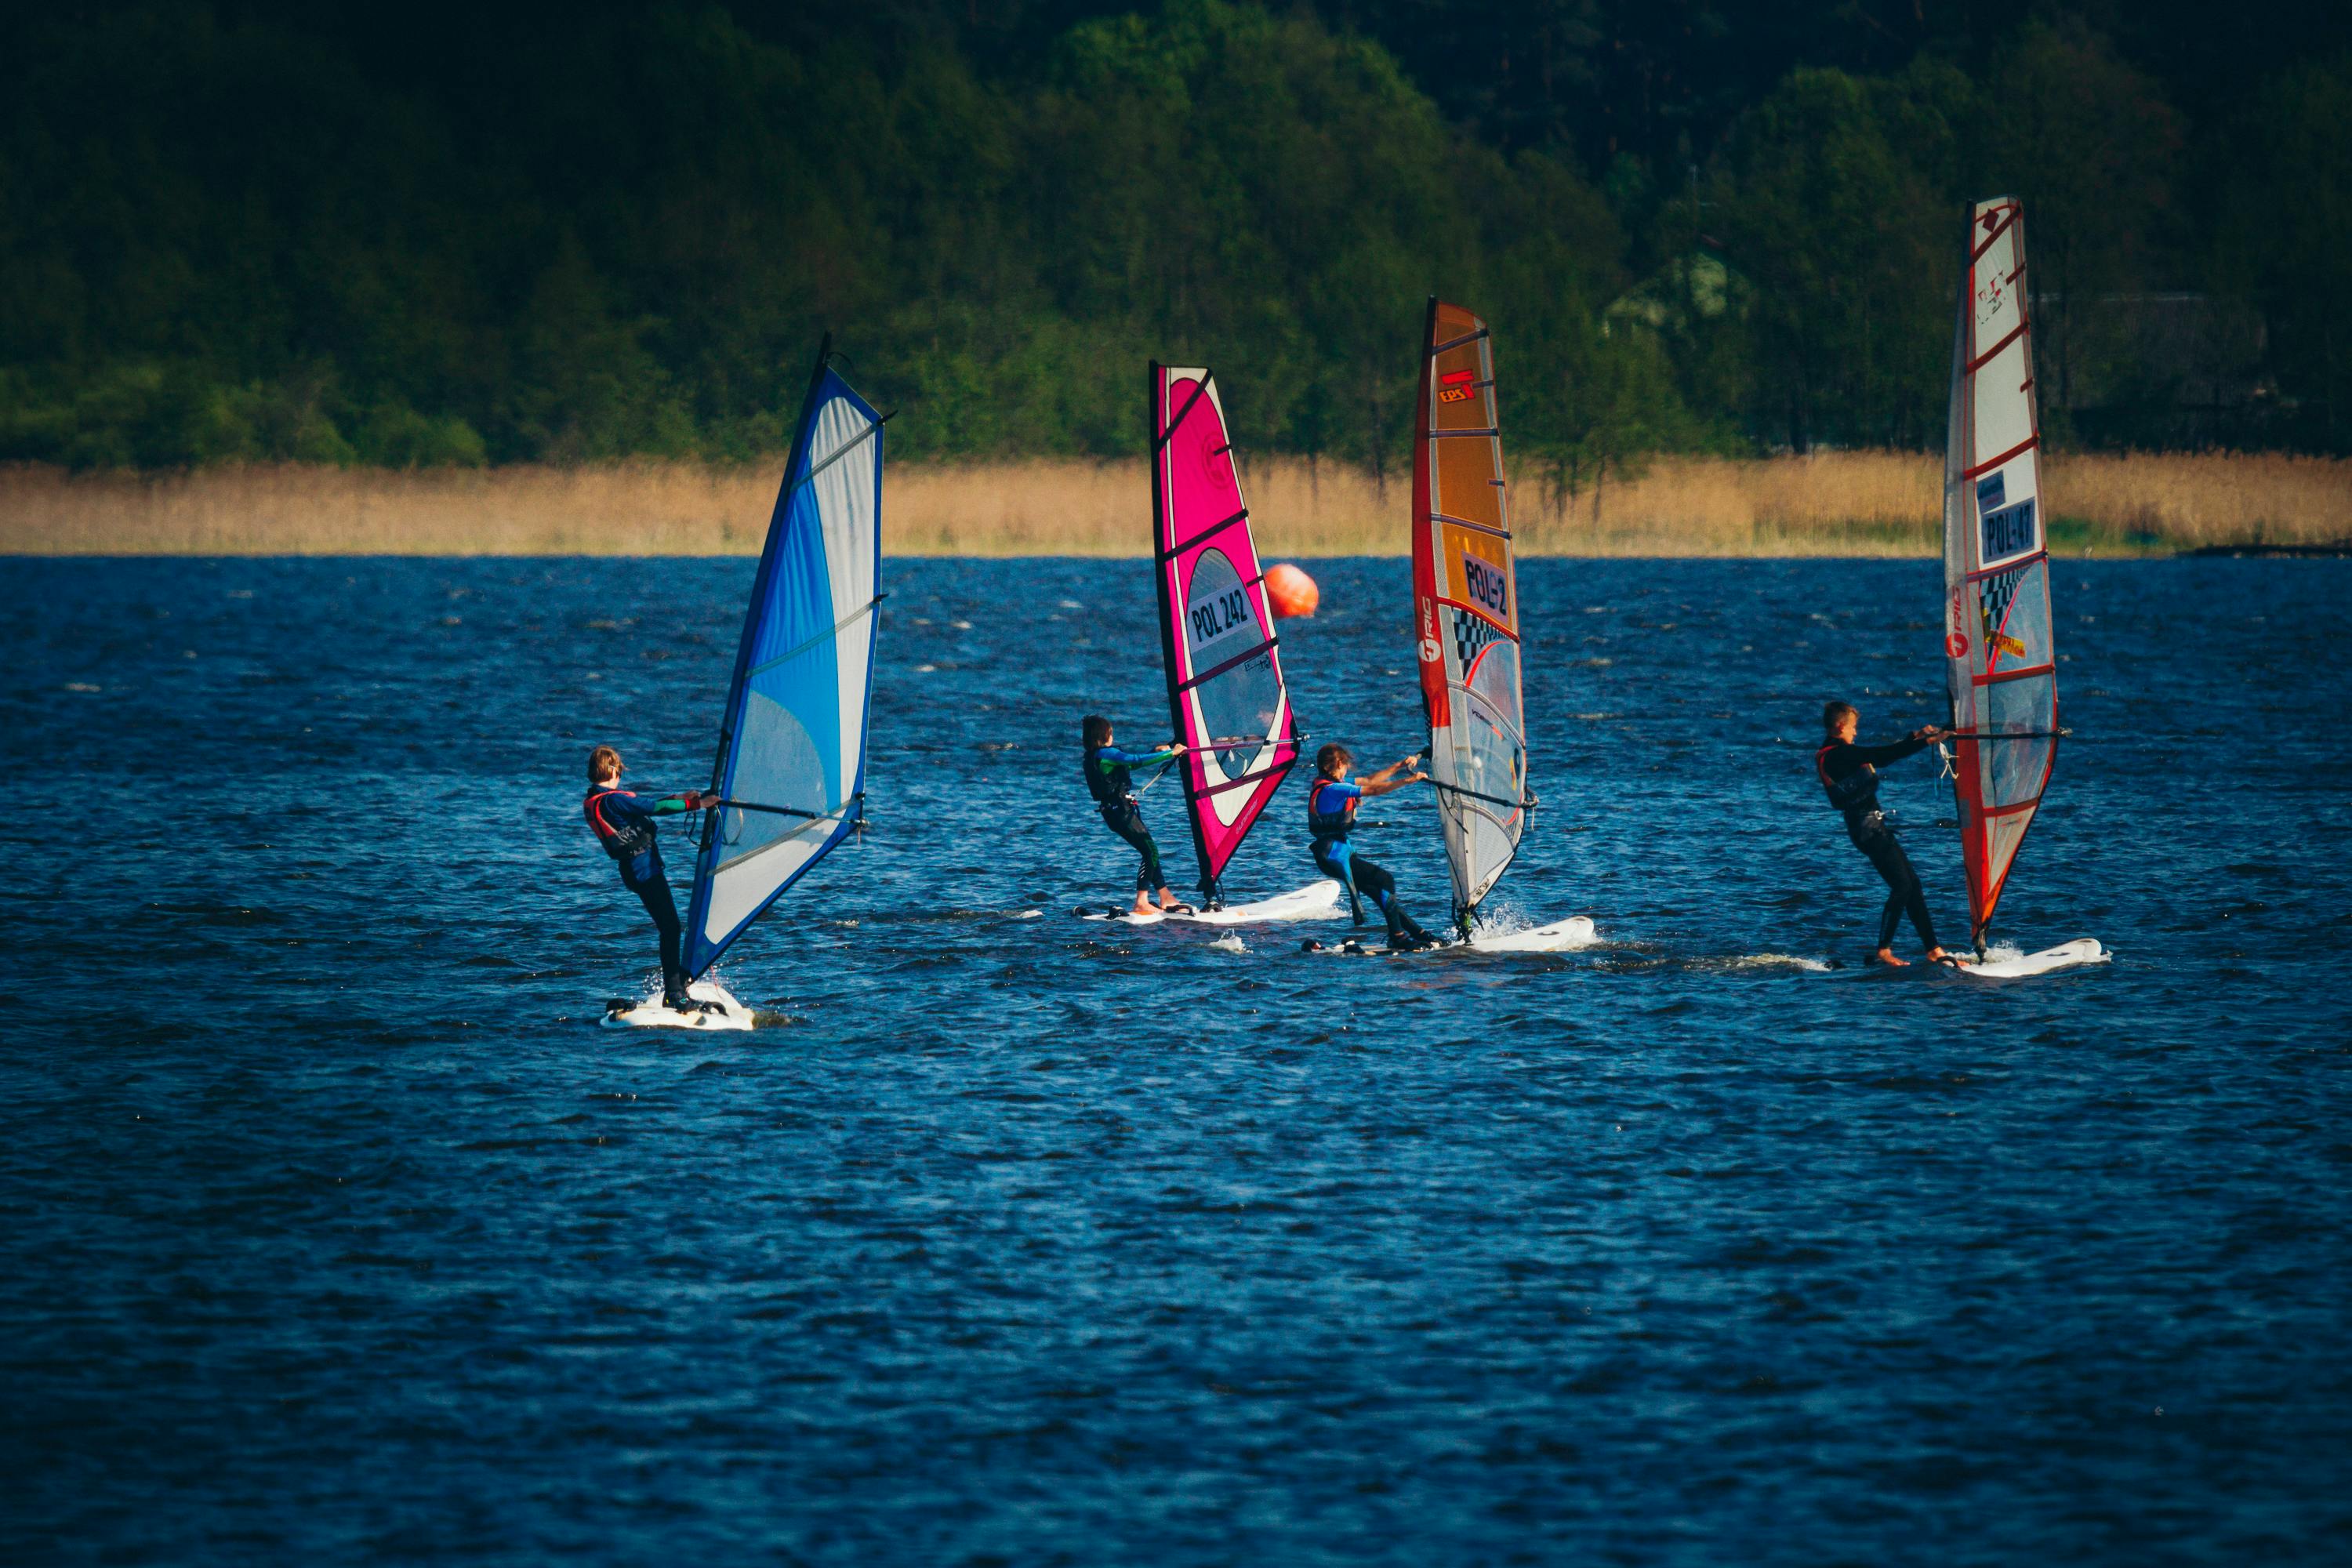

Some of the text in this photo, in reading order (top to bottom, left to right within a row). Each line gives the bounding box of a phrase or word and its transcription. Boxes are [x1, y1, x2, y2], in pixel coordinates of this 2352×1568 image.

[1465, 559, 1507, 616] POL-2
[1191, 589, 1248, 642] POL 242
